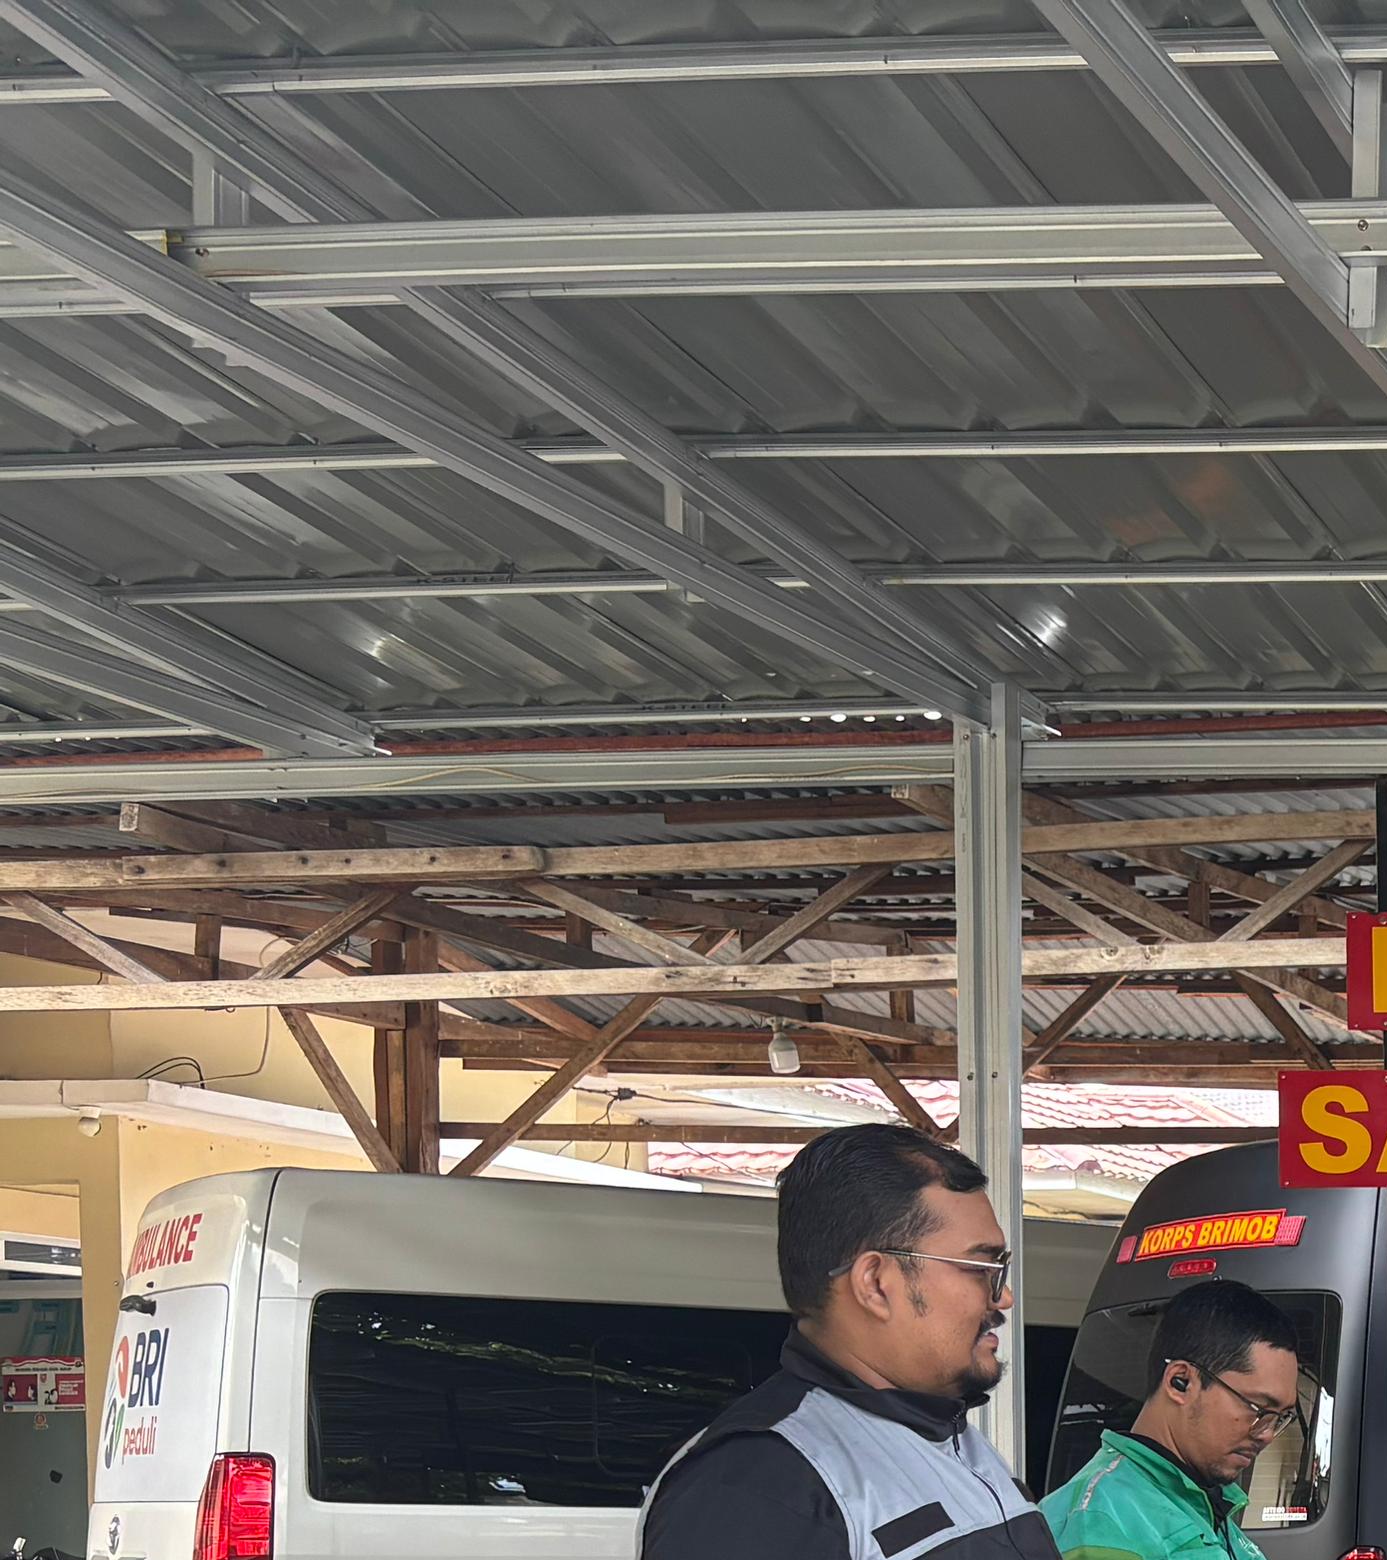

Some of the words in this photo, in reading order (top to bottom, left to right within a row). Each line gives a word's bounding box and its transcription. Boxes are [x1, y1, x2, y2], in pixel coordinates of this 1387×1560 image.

[127, 1213, 203, 1280] BULANCE
[1139, 1223, 1195, 1256] KORPS
[1197, 1214, 1281, 1248] BRIMOB
[127, 1327, 170, 1408] BRI
[122, 1415, 158, 1465] peduli
